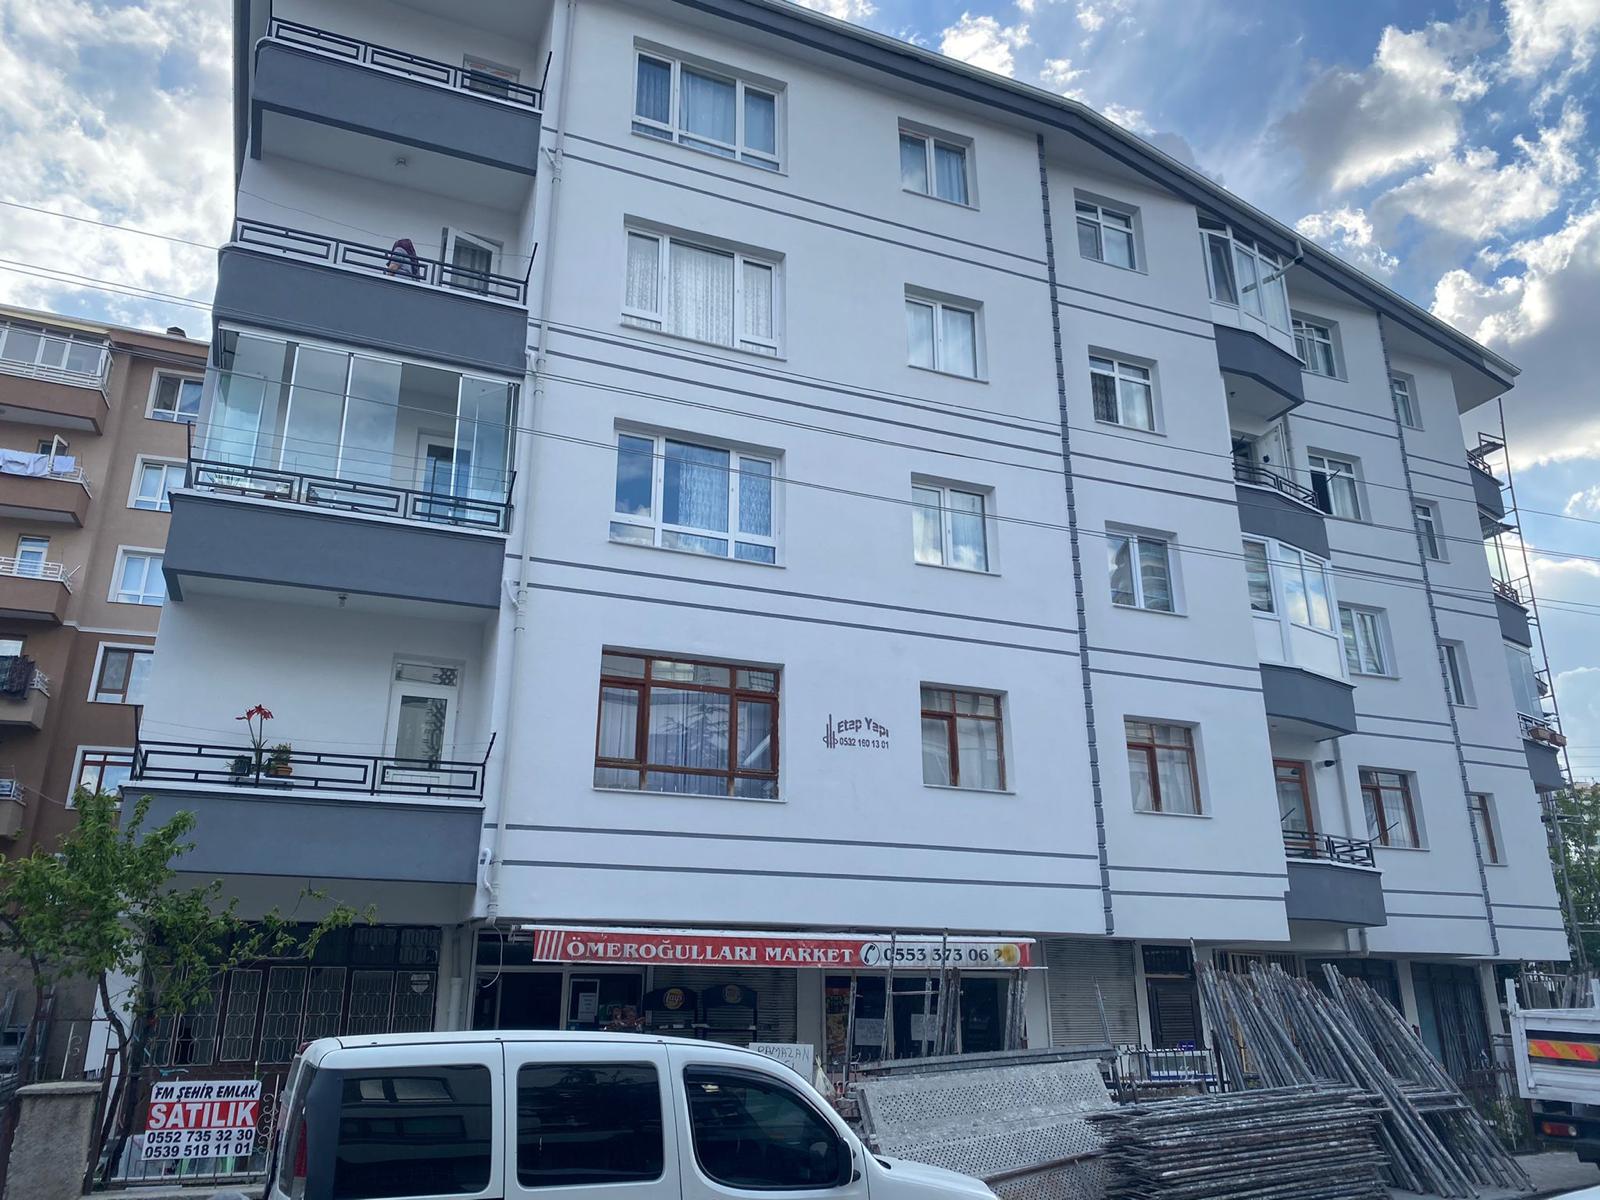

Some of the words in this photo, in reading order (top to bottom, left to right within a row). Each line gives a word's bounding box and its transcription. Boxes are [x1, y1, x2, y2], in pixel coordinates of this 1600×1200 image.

[837, 719, 862, 733] Etap
[864, 717, 889, 738] Yapı
[839, 737, 856, 747] 0532
[567, 936, 757, 961] ÖMEROĞULLARI
[765, 946, 854, 963] MARKET
[883, 948, 926, 962] 0553
[932, 948, 963, 962] 373
[968, 948, 989, 962] 06
[154, 1086, 175, 1100] FM
[176, 1083, 214, 1102] ŞEHİR
[216, 1083, 258, 1099] EMLAK
[149, 1102, 256, 1129] SATILIK
[147, 1131, 182, 1144] 0552
[187, 1130, 211, 1142] 735
[216, 1129, 233, 1142] 32
[236, 1129, 253, 1141] 30
[144, 1145, 180, 1158] 0539
[184, 1144, 209, 1157] 518
[214, 1143, 230, 1155] 11
[234, 1142, 250, 1155] 01
